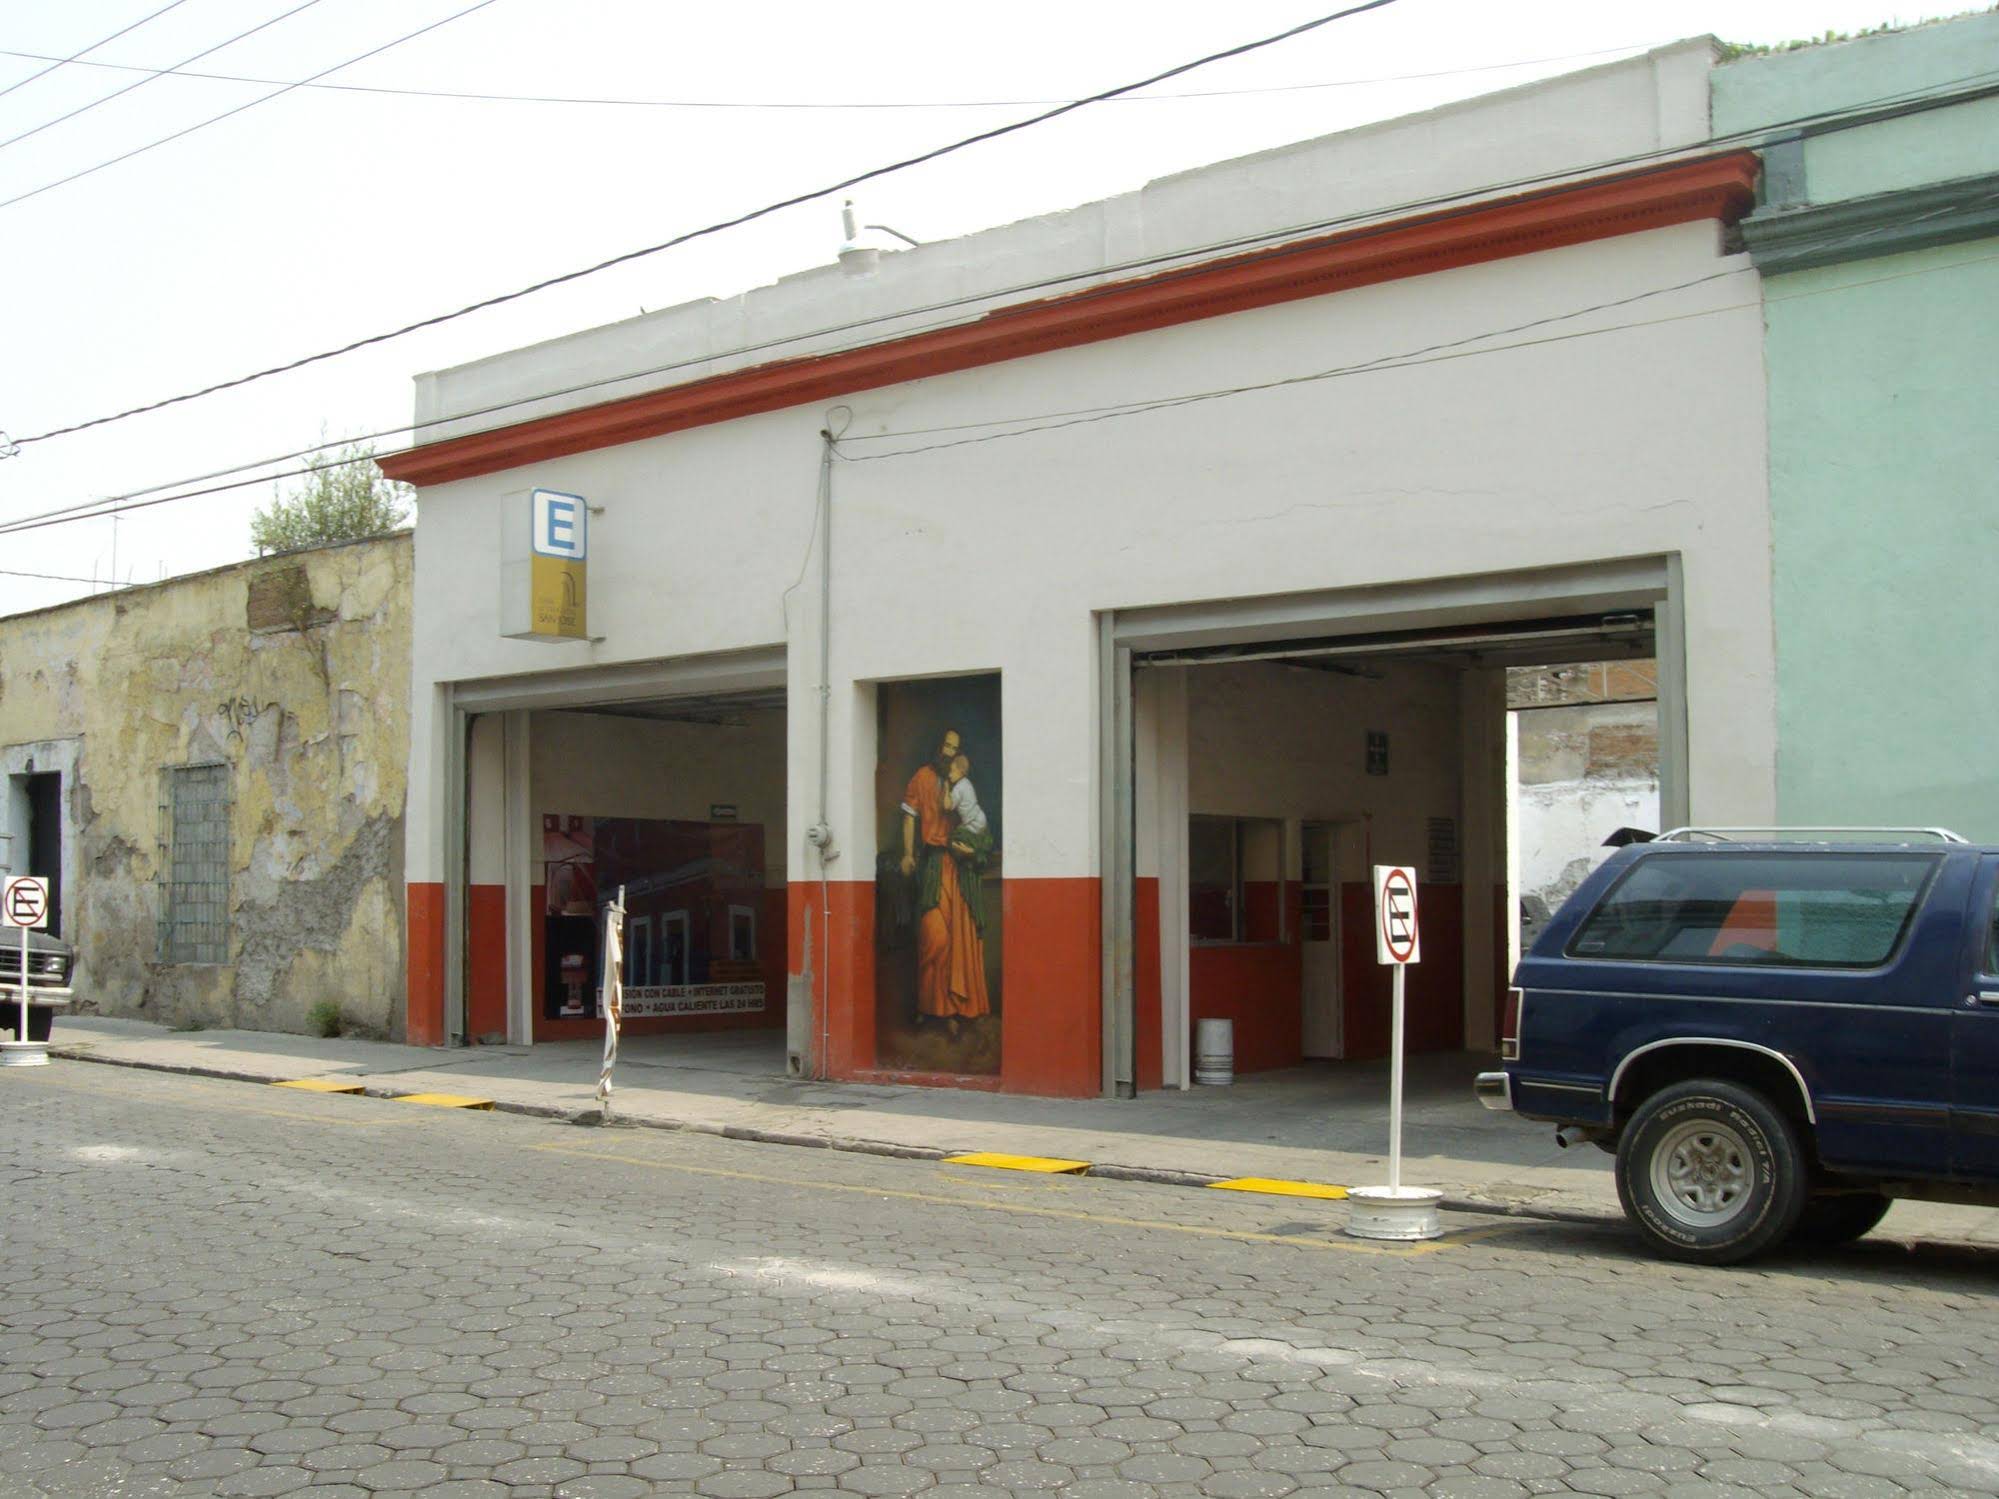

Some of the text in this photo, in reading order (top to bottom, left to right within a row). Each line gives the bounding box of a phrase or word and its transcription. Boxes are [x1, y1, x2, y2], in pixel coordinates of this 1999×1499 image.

[548, 500, 575, 550] E
[13, 886, 38, 917] E
[1388, 887, 1409, 943] E
[645, 988, 660, 998] CON
[662, 987, 685, 998] CABLE
[693, 985, 728, 996] INTERNET
[653, 1002, 675, 1012] AGUA
[678, 1000, 718, 1011] CALIENTE
[720, 999, 735, 1009] LAS
